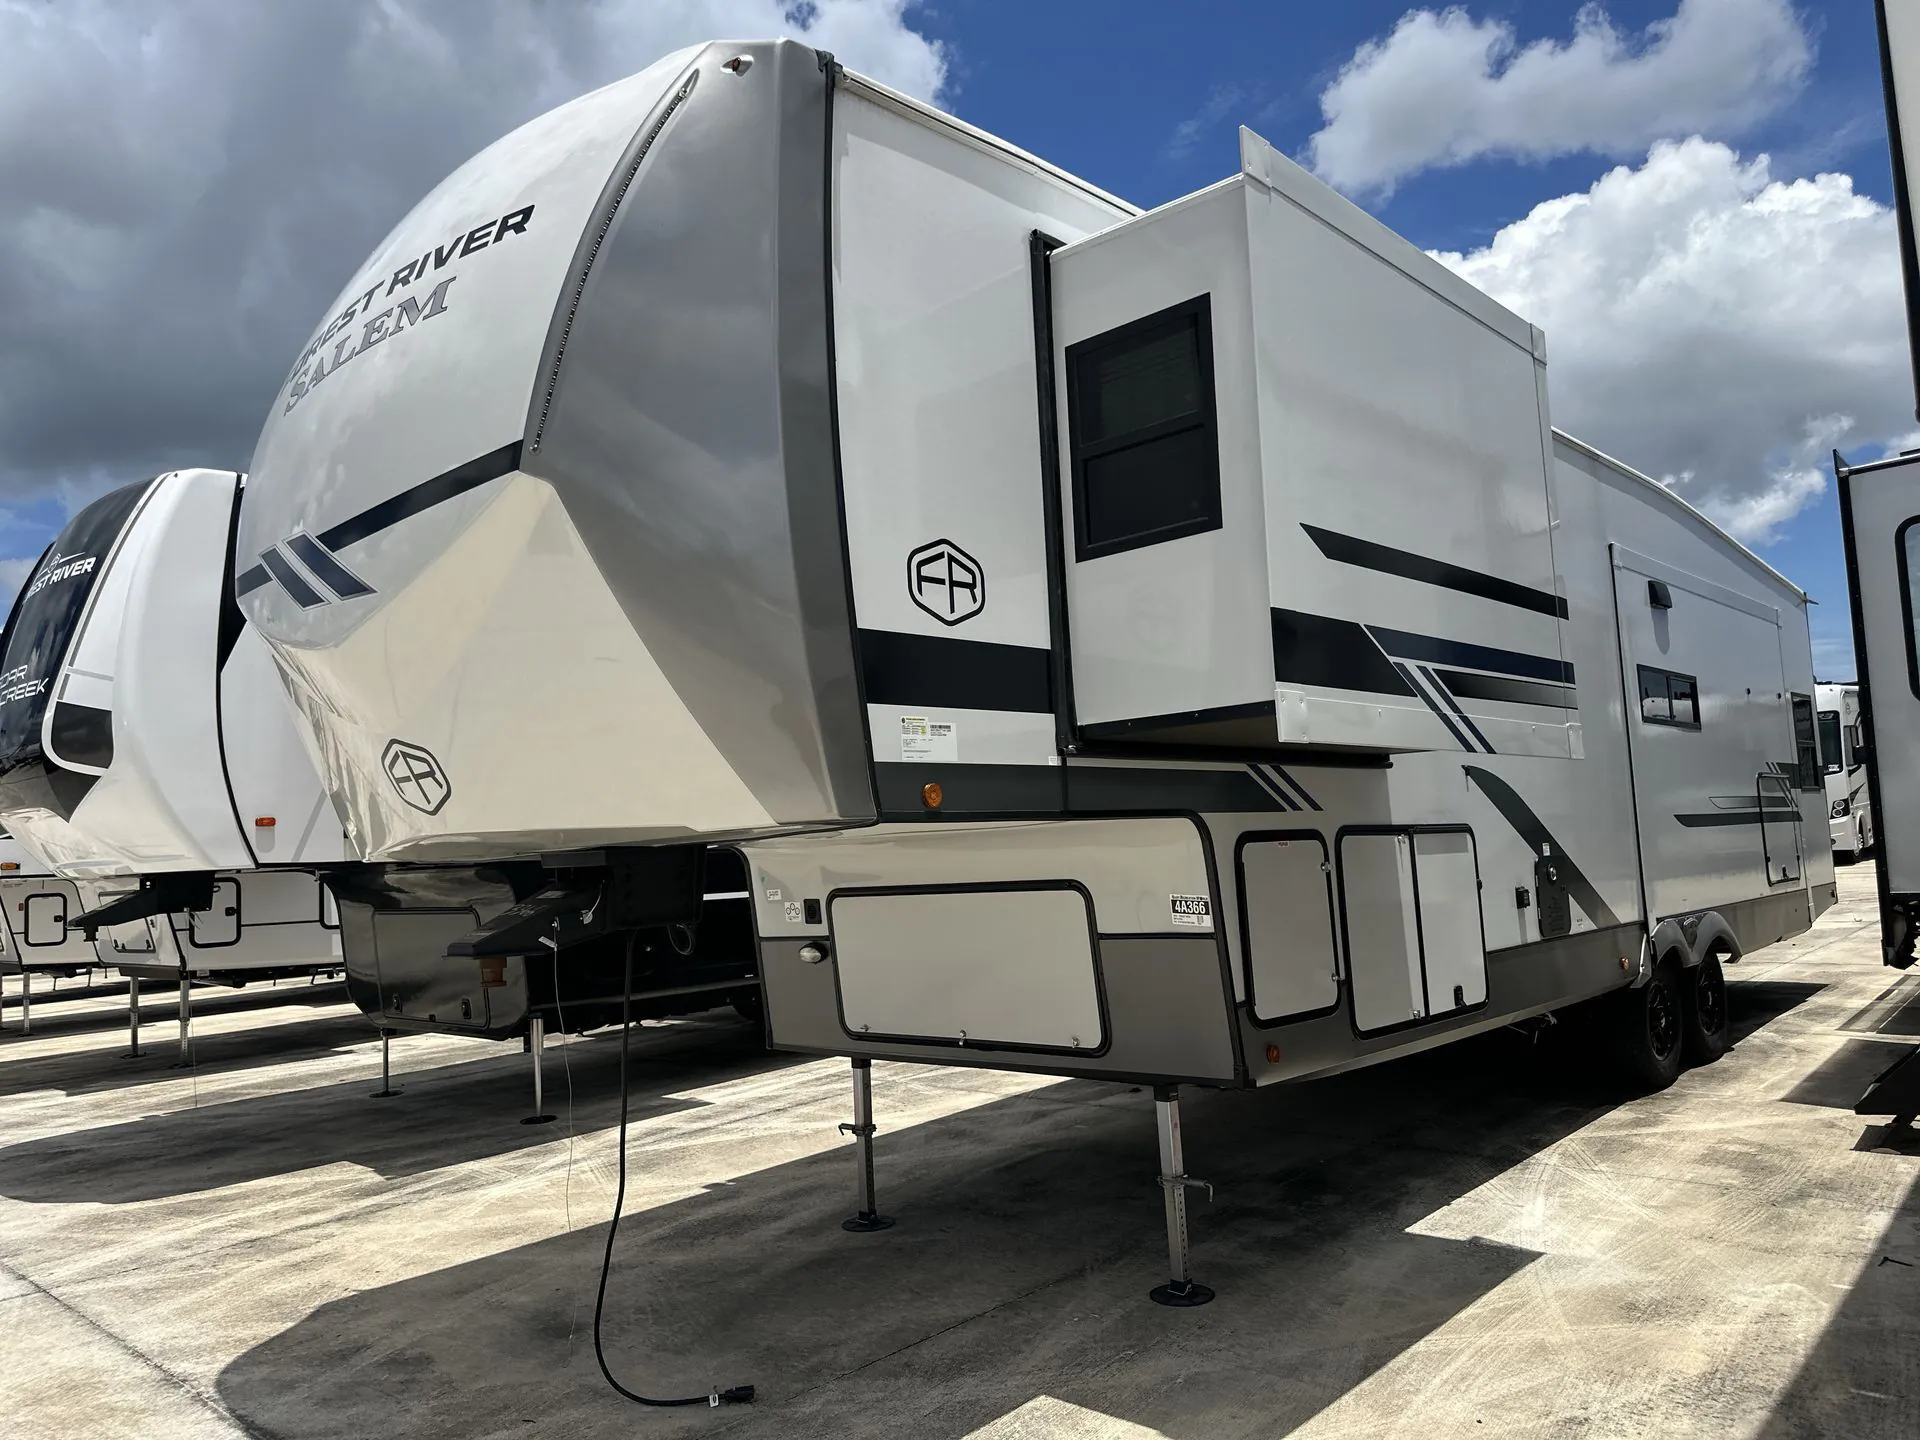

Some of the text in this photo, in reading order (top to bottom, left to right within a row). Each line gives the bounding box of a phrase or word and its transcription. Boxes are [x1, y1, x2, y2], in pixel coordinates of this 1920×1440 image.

[386, 204, 535, 297] RIVER
[283, 275, 457, 417] SALEM
[49, 557, 96, 585] RIVER
[0, 677, 49, 706] CREEK
[1175, 900, 1206, 914] 4A366
